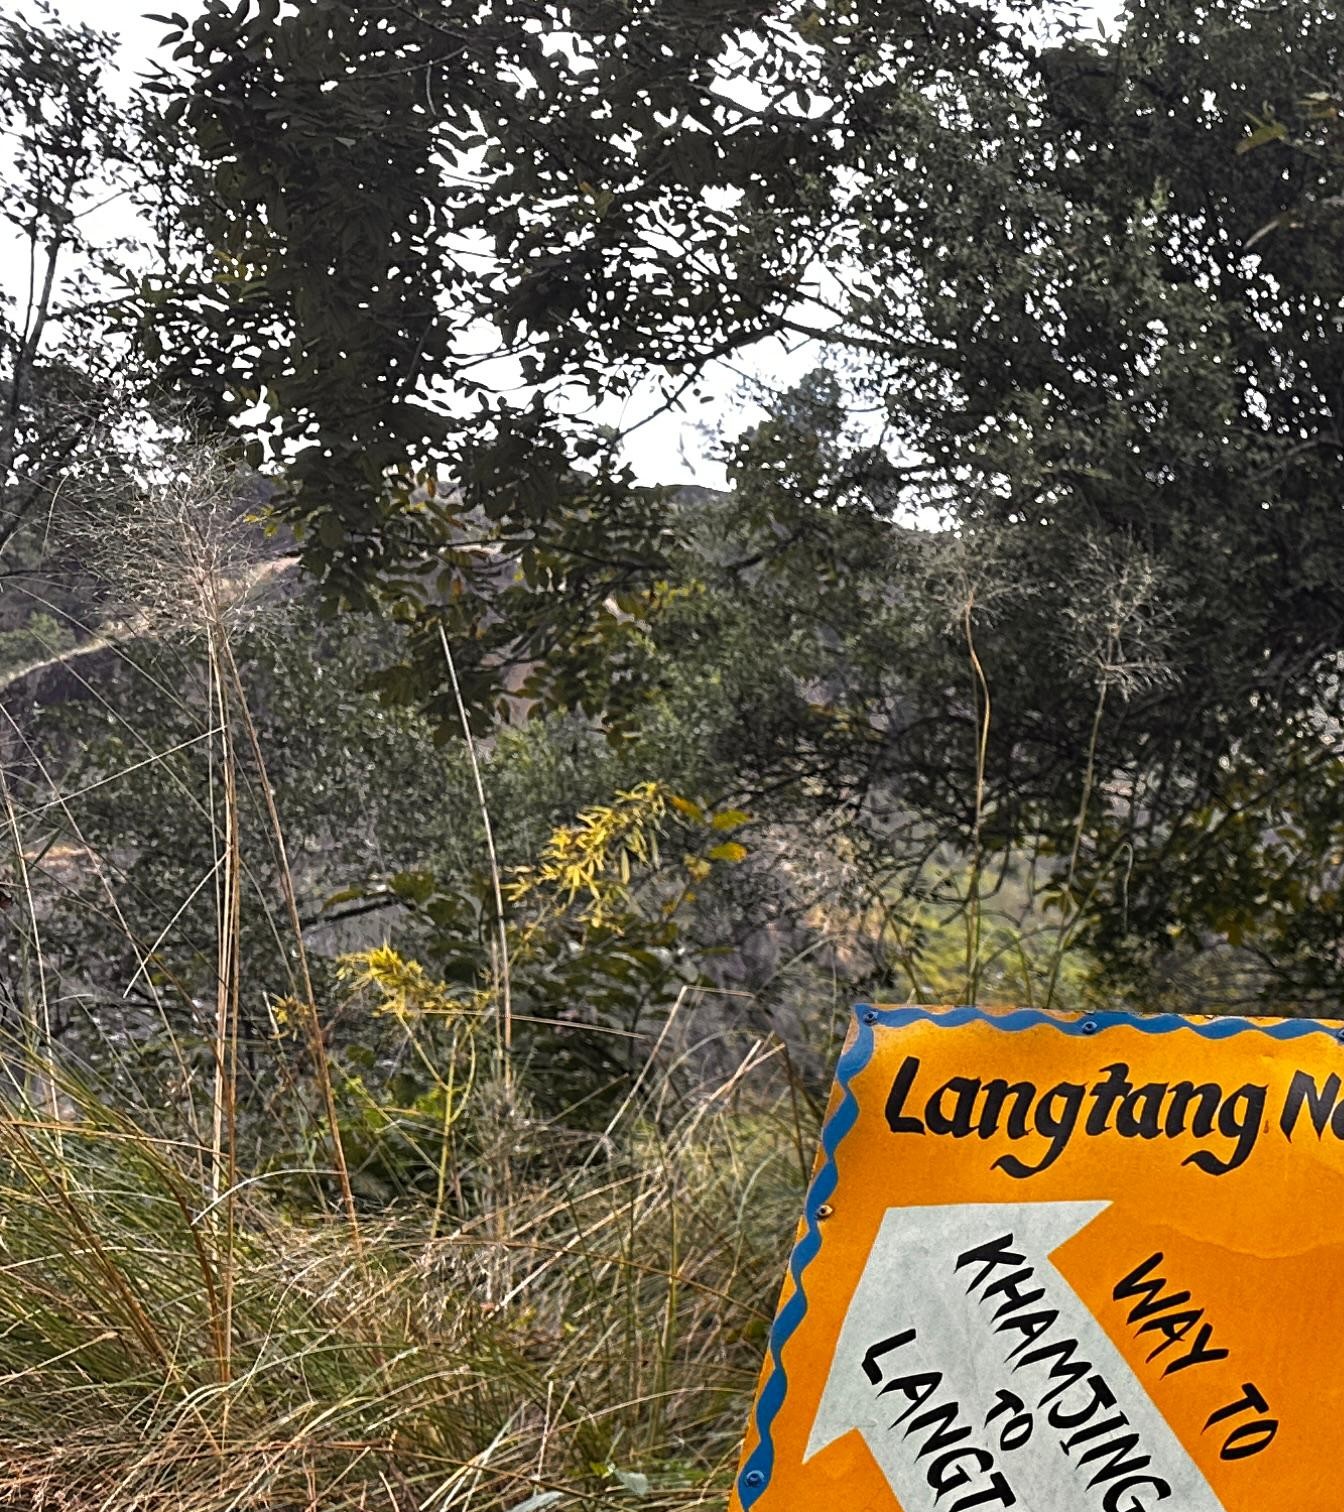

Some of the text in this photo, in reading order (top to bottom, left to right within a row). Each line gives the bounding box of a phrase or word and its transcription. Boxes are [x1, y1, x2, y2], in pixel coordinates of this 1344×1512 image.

[882, 1054, 1268, 1180] Langtang
[1111, 1251, 1280, 1462] WAY TO
[983, 1387, 1035, 1453] TO
